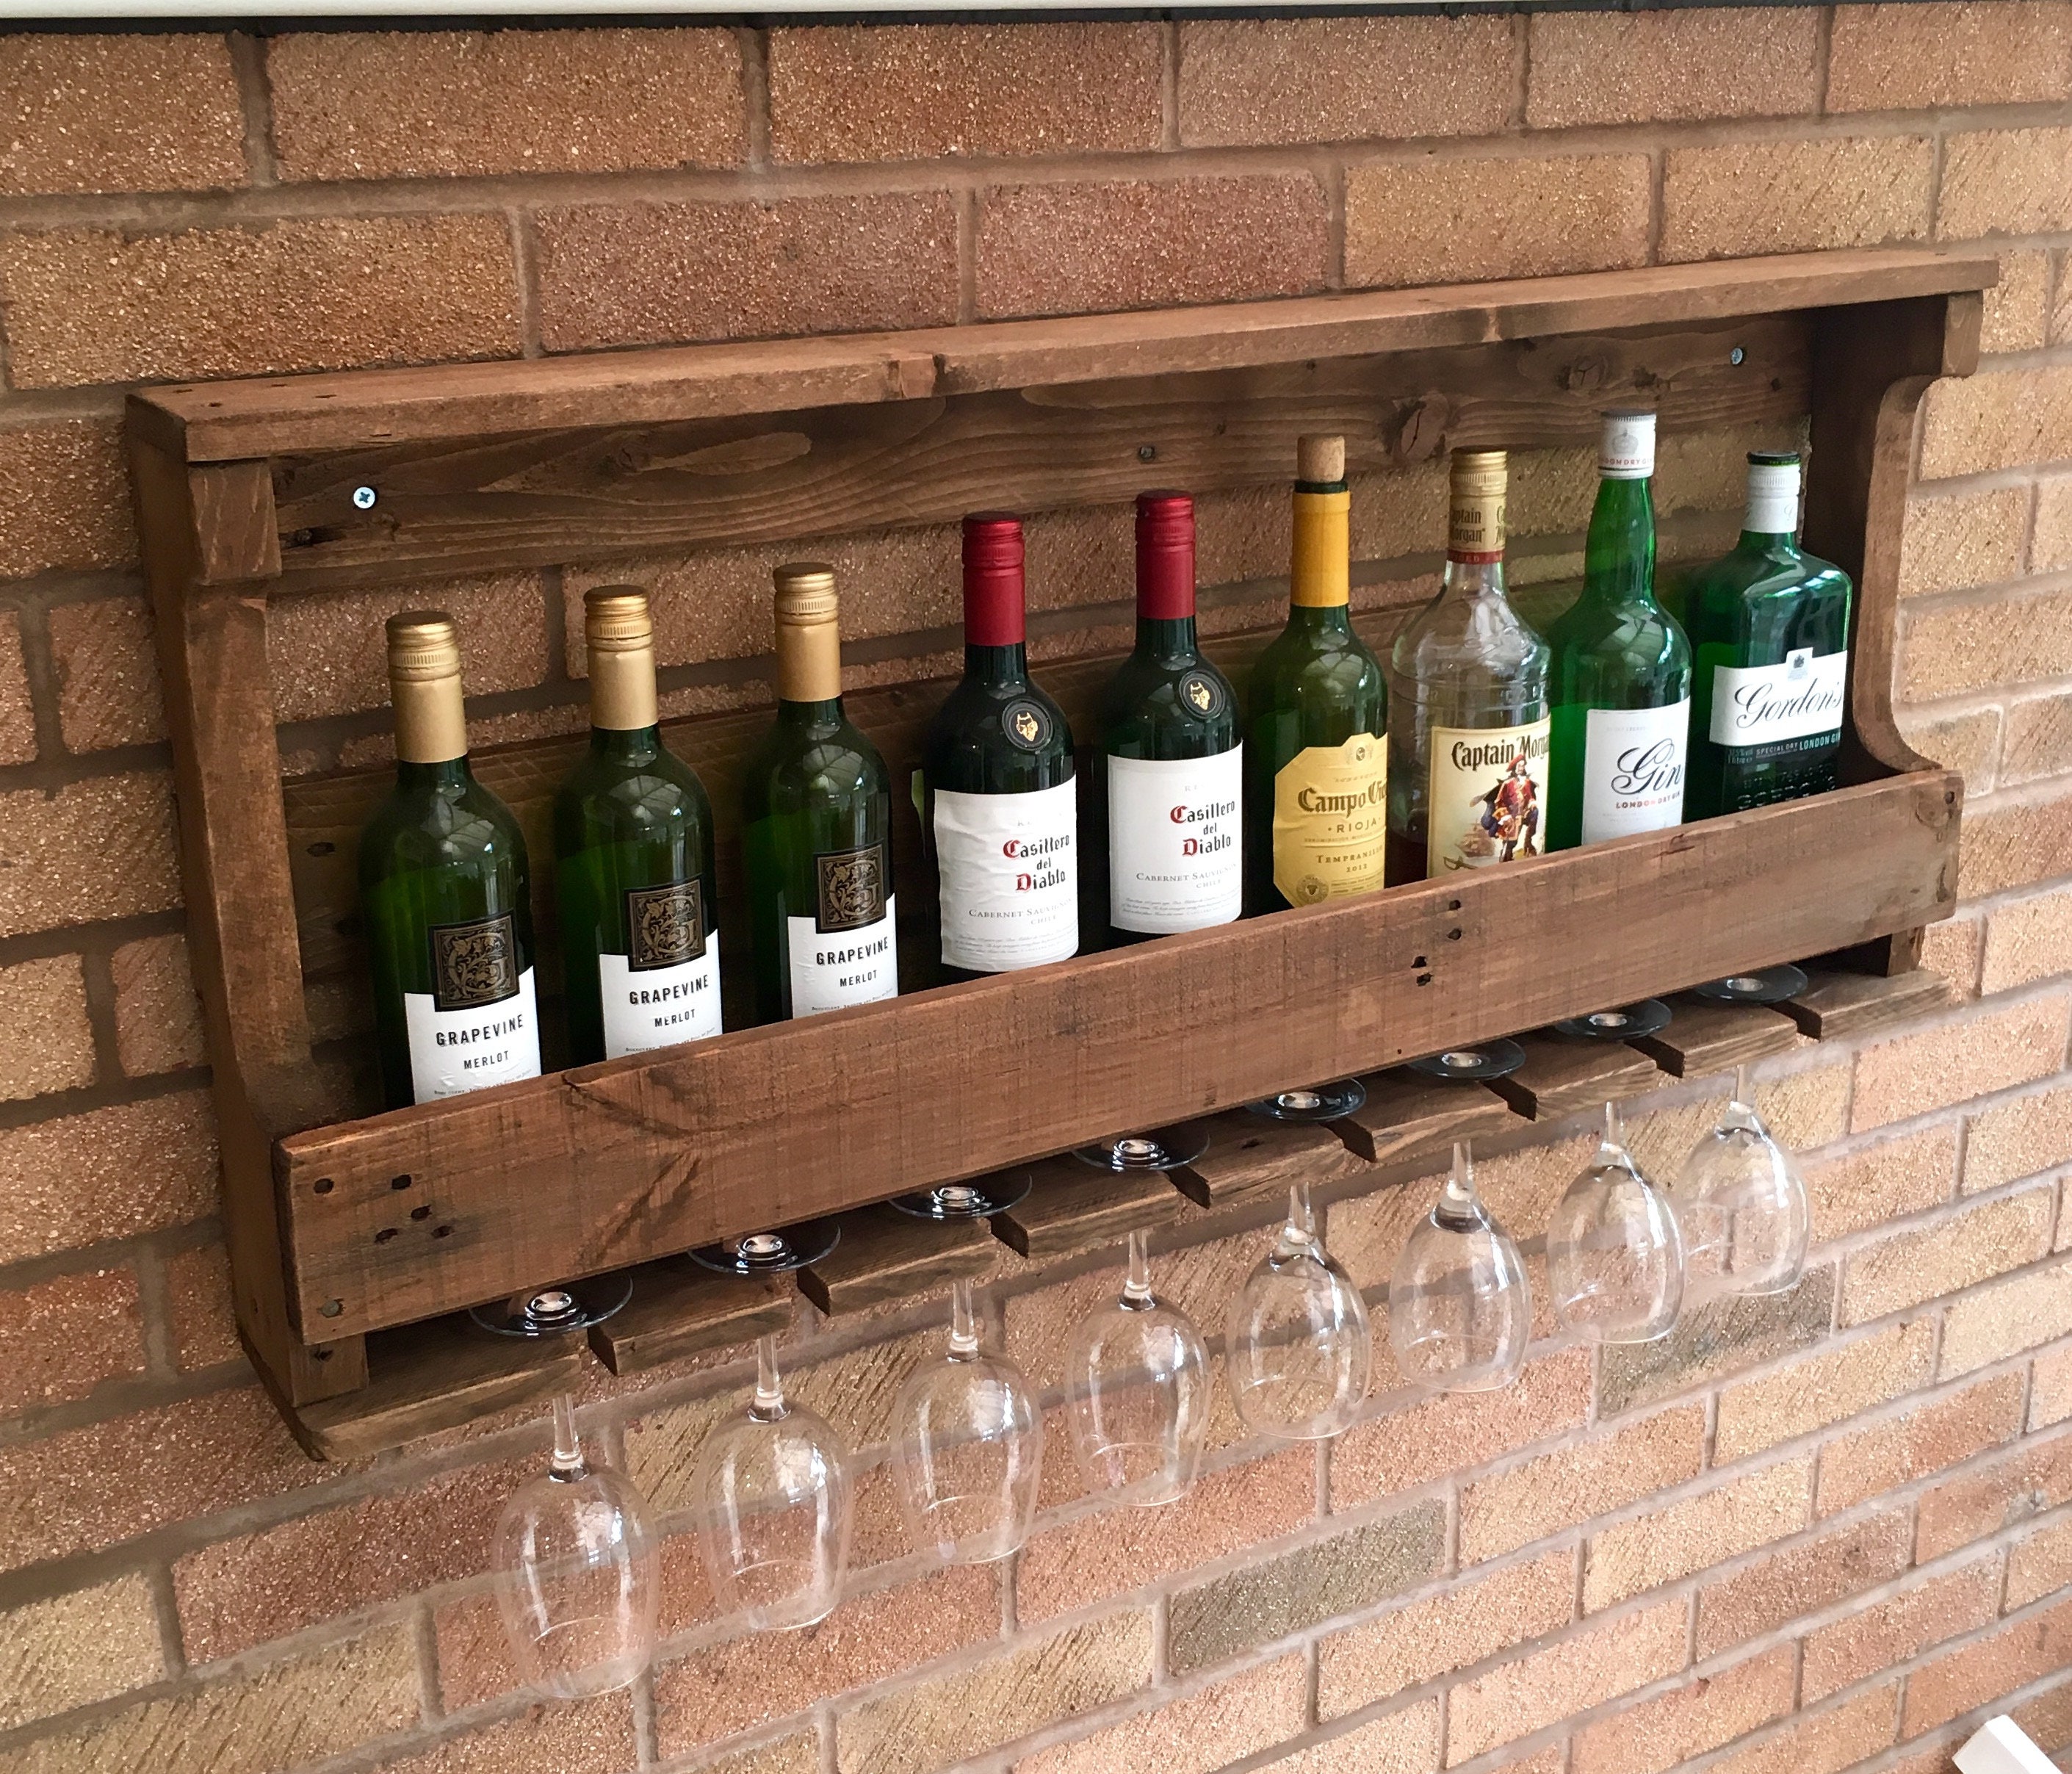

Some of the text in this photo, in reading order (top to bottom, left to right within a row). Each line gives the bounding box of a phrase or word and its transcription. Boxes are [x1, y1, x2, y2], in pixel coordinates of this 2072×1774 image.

[1734, 677, 1843, 728] Gordon's
[1451, 738, 1515, 771] Captain
[1756, 745, 1783, 755] SPECIAL
[1799, 735, 1830, 751] LONDON
[1611, 738, 1683, 795] Gin
[1170, 801, 1235, 823] Casillero
[1298, 787, 1366, 818] Campo
[1616, 799, 1656, 809] LONDON
[1203, 823, 1217, 835] del
[1336, 818, 1377, 833] RIOJA
[1003, 834, 1069, 859] Casillero
[1182, 834, 1231, 857] Diablo
[1036, 857, 1052, 870] del
[1015, 869, 1066, 894] Diablo
[1136, 873, 1189, 881] CABERNET
[969, 909, 1023, 918] CABERNET
[816, 937, 889, 966] GRAPEVINE
[629, 974, 709, 1005] GRAPEVINE
[840, 970, 878, 987] MERLOT
[654, 1009, 696, 1028] MERLOT
[436, 1014, 524, 1047] GRAPEVINE
[463, 1050, 509, 1070] MERLOT
